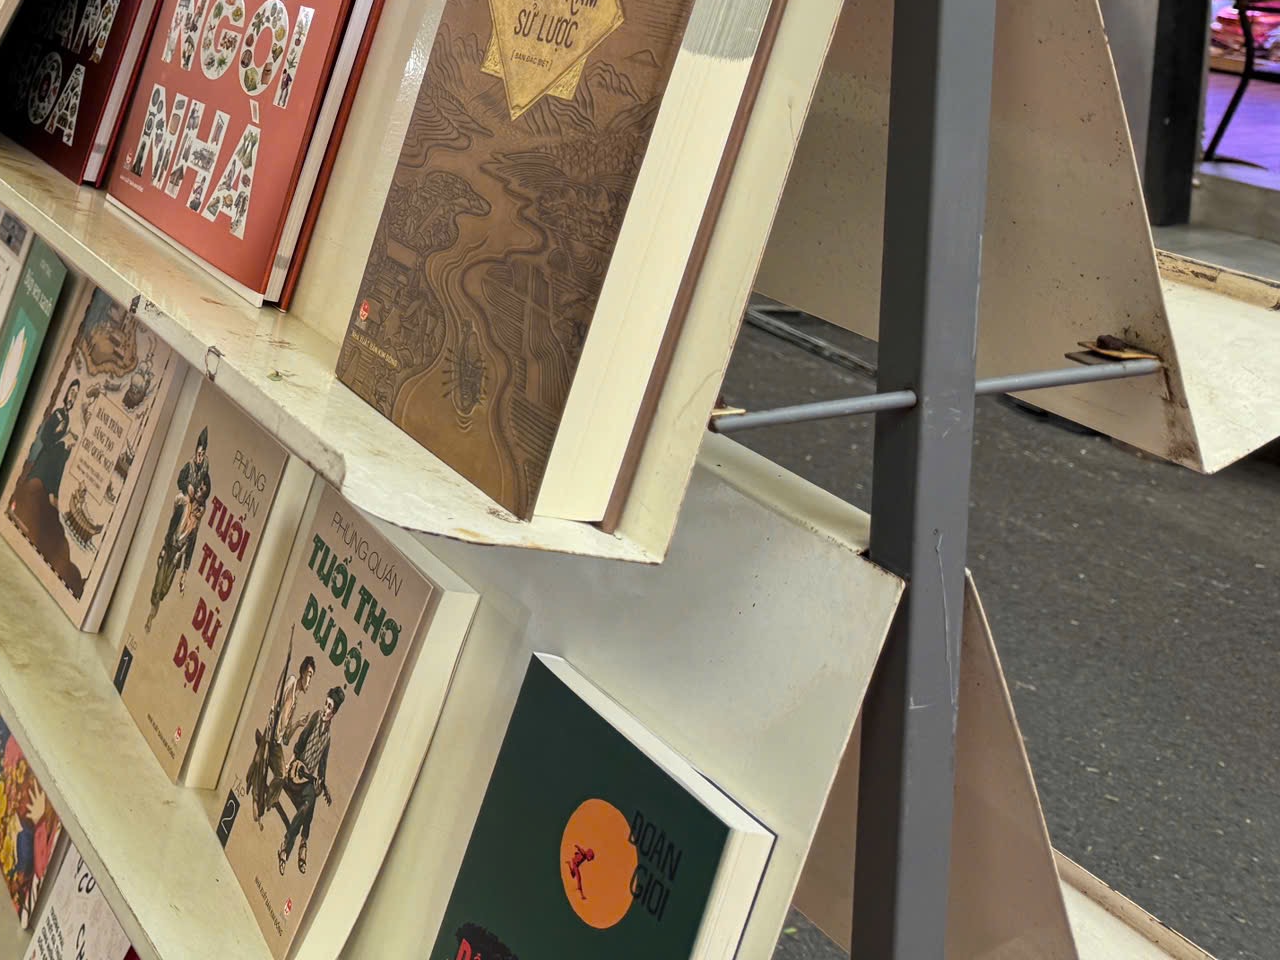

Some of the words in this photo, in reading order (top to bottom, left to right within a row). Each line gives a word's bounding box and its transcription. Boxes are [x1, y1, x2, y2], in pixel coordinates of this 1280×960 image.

[513, 2, 539, 38] SỬ
[536, 14, 579, 52] LƯỢC
[131, 83, 262, 240] NHÀ
[231, 480, 260, 518] QUÁN
[232, 449, 267, 493] PHÙNG
[207, 495, 251, 562] TUỔI
[331, 511, 369, 561] PHÙNG
[367, 551, 403, 598] QUÁN
[196, 542, 236, 602] THƠ
[308, 533, 357, 609] TUỔI
[353, 585, 402, 657] THƠ
[120, 656, 129, 680] 1
[173, 633, 206, 694] DỘI
[328, 627, 370, 697] DỘI
[221, 799, 236, 835] 2
